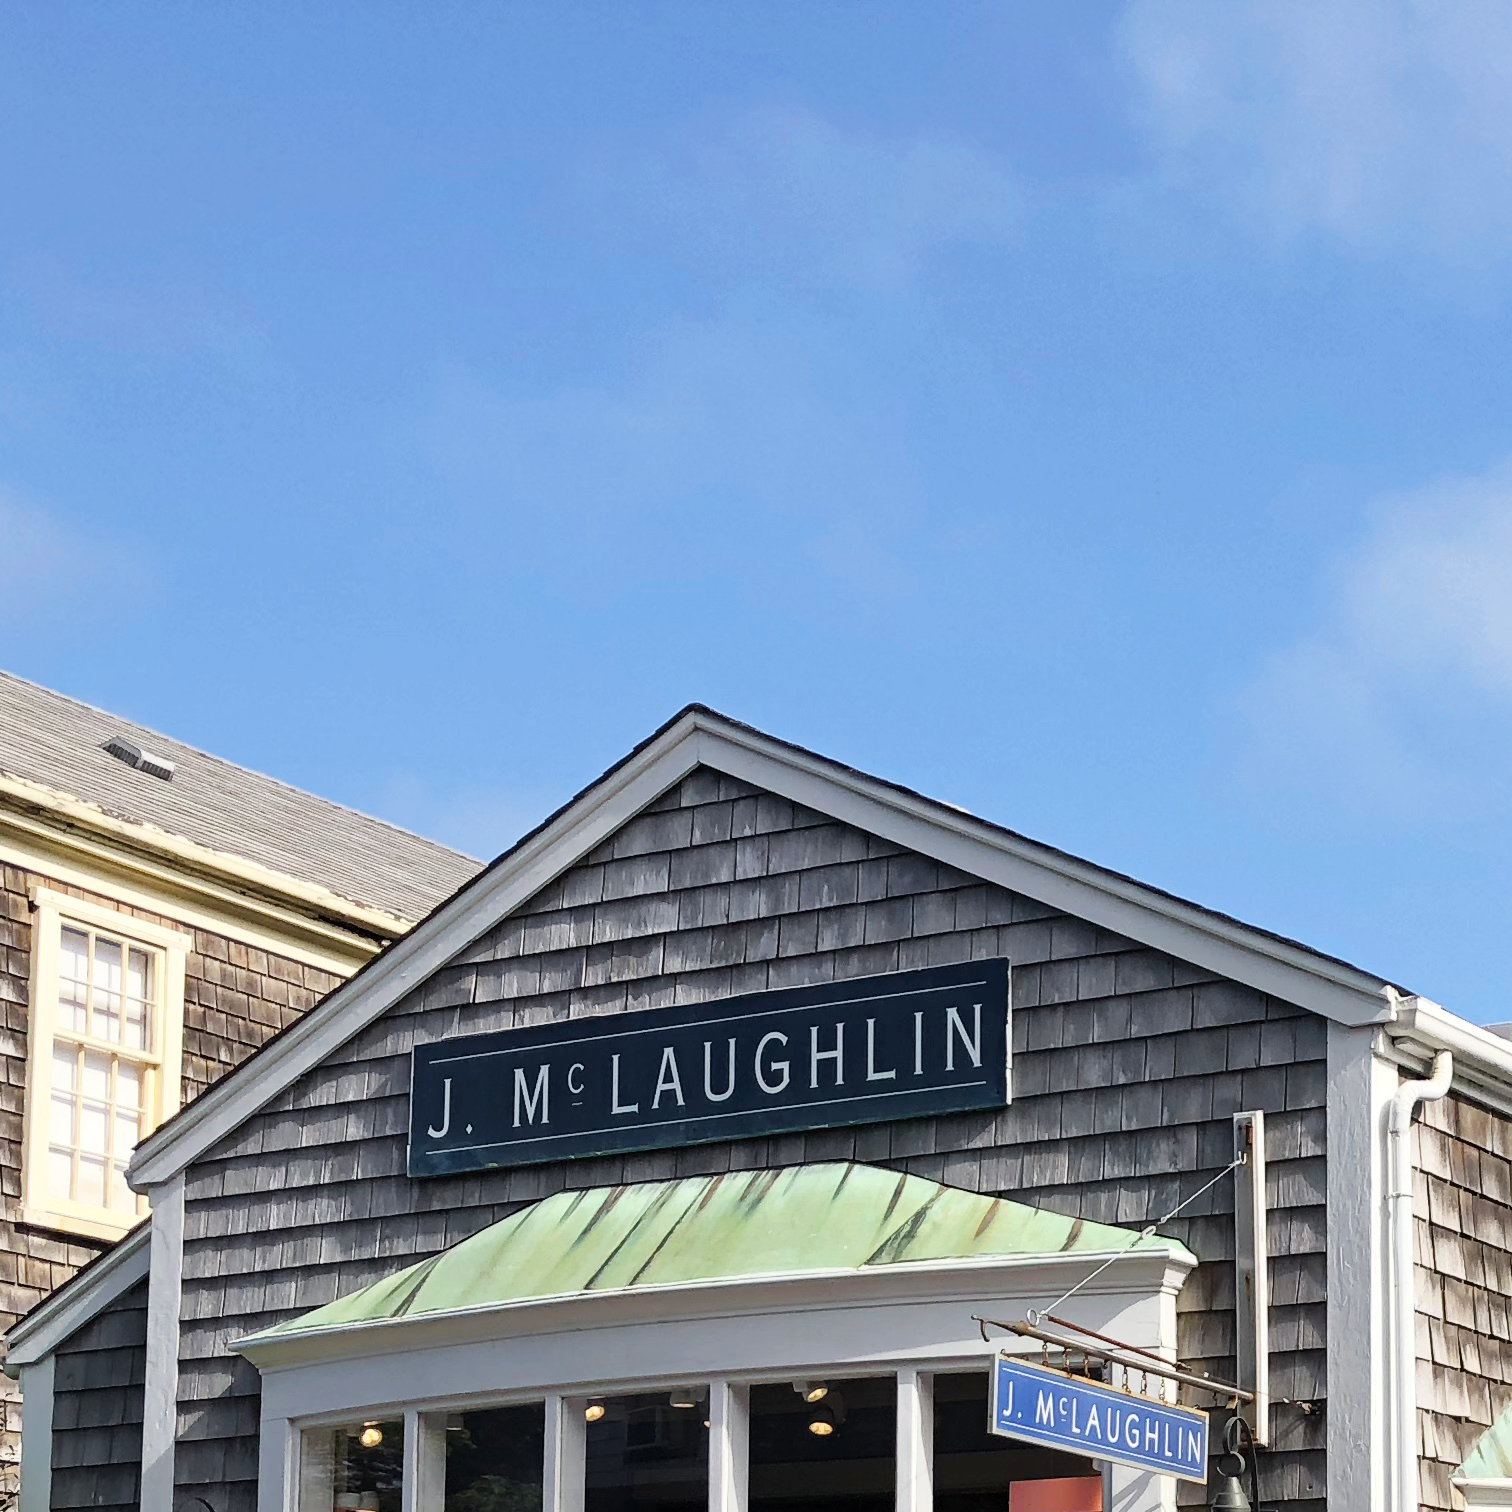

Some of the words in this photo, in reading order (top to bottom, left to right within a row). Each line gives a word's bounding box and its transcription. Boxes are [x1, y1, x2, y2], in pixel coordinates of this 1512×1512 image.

[426, 1078, 474, 1140] J.
[511, 1003, 984, 1129] McLAUGHLIN
[1002, 1381, 1023, 1418] J.
[1035, 1389, 1201, 1465] McLAUGHLIN
